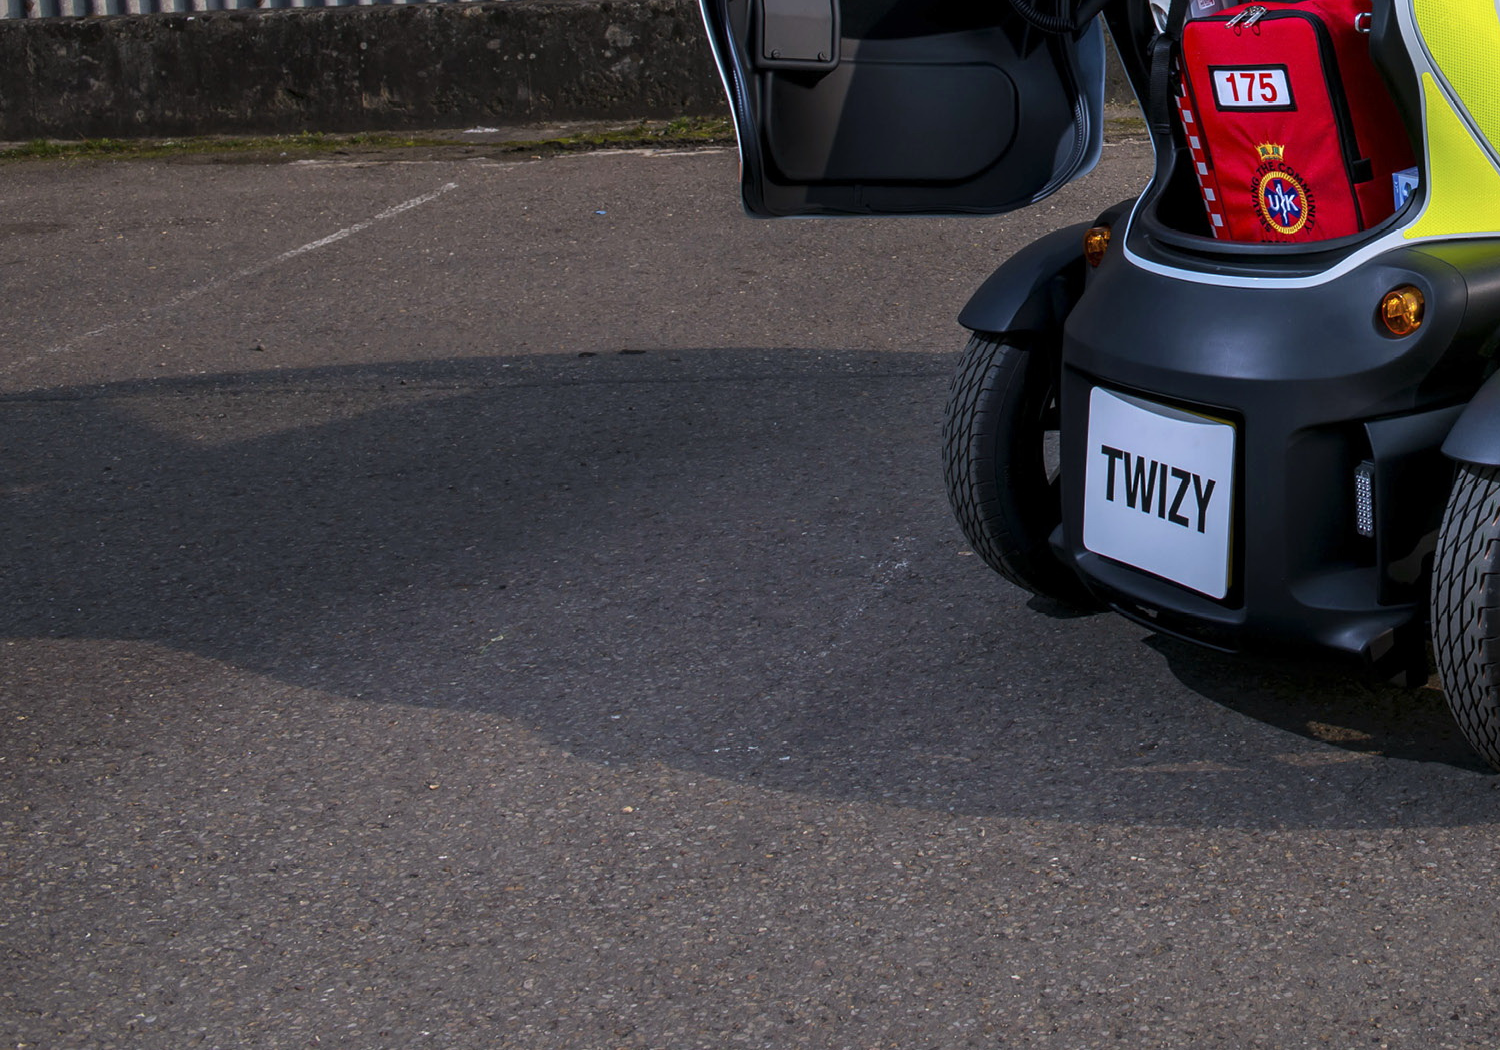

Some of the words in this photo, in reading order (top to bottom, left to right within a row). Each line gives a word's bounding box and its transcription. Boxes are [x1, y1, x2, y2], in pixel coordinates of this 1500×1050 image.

[1225, 72, 1278, 103] 175
[1256, 161, 1276, 178] THE
[1250, 176, 1273, 233] SERVING
[1277, 162, 1316, 235] COMMUNITY
[1101, 444, 1216, 534] TWIZY
